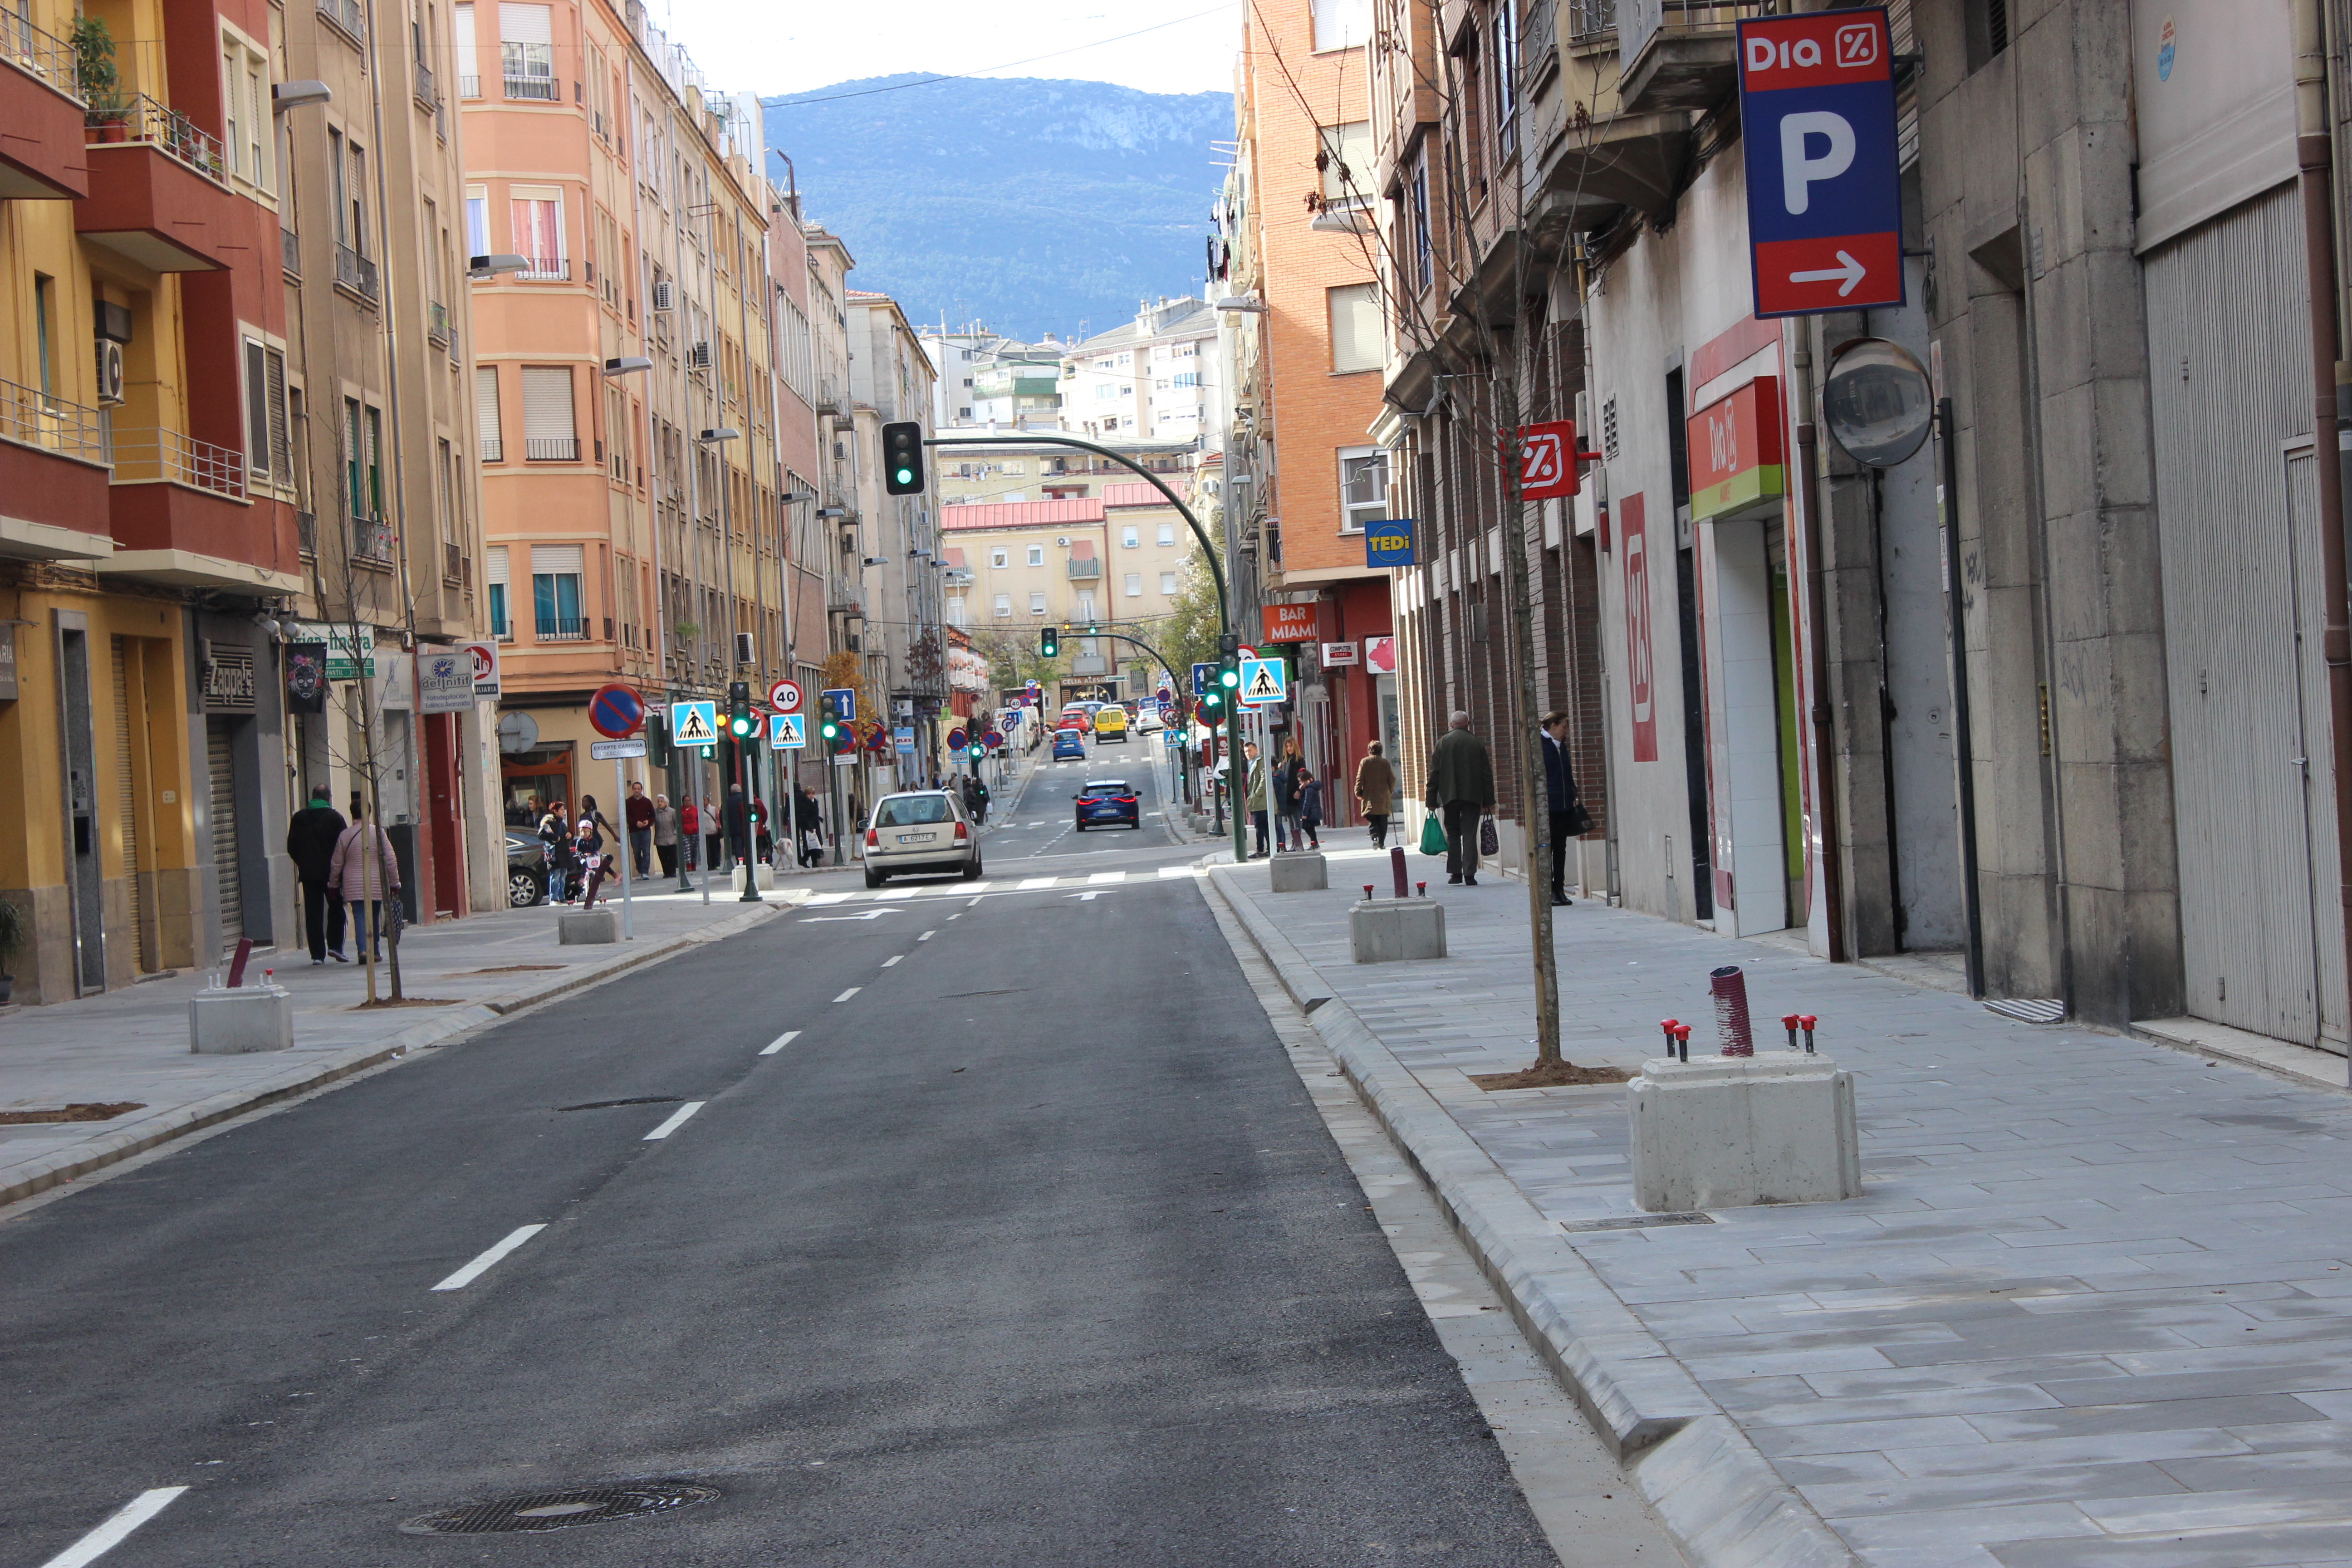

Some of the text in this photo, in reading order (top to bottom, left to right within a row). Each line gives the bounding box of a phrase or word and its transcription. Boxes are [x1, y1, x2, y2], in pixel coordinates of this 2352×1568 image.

[1780, 111, 1856, 215] P
[1369, 535, 1410, 552] TEDi
[1279, 607, 1306, 622] BAR
[1271, 623, 1317, 639] MIAMI
[776, 691, 795, 702] 40
